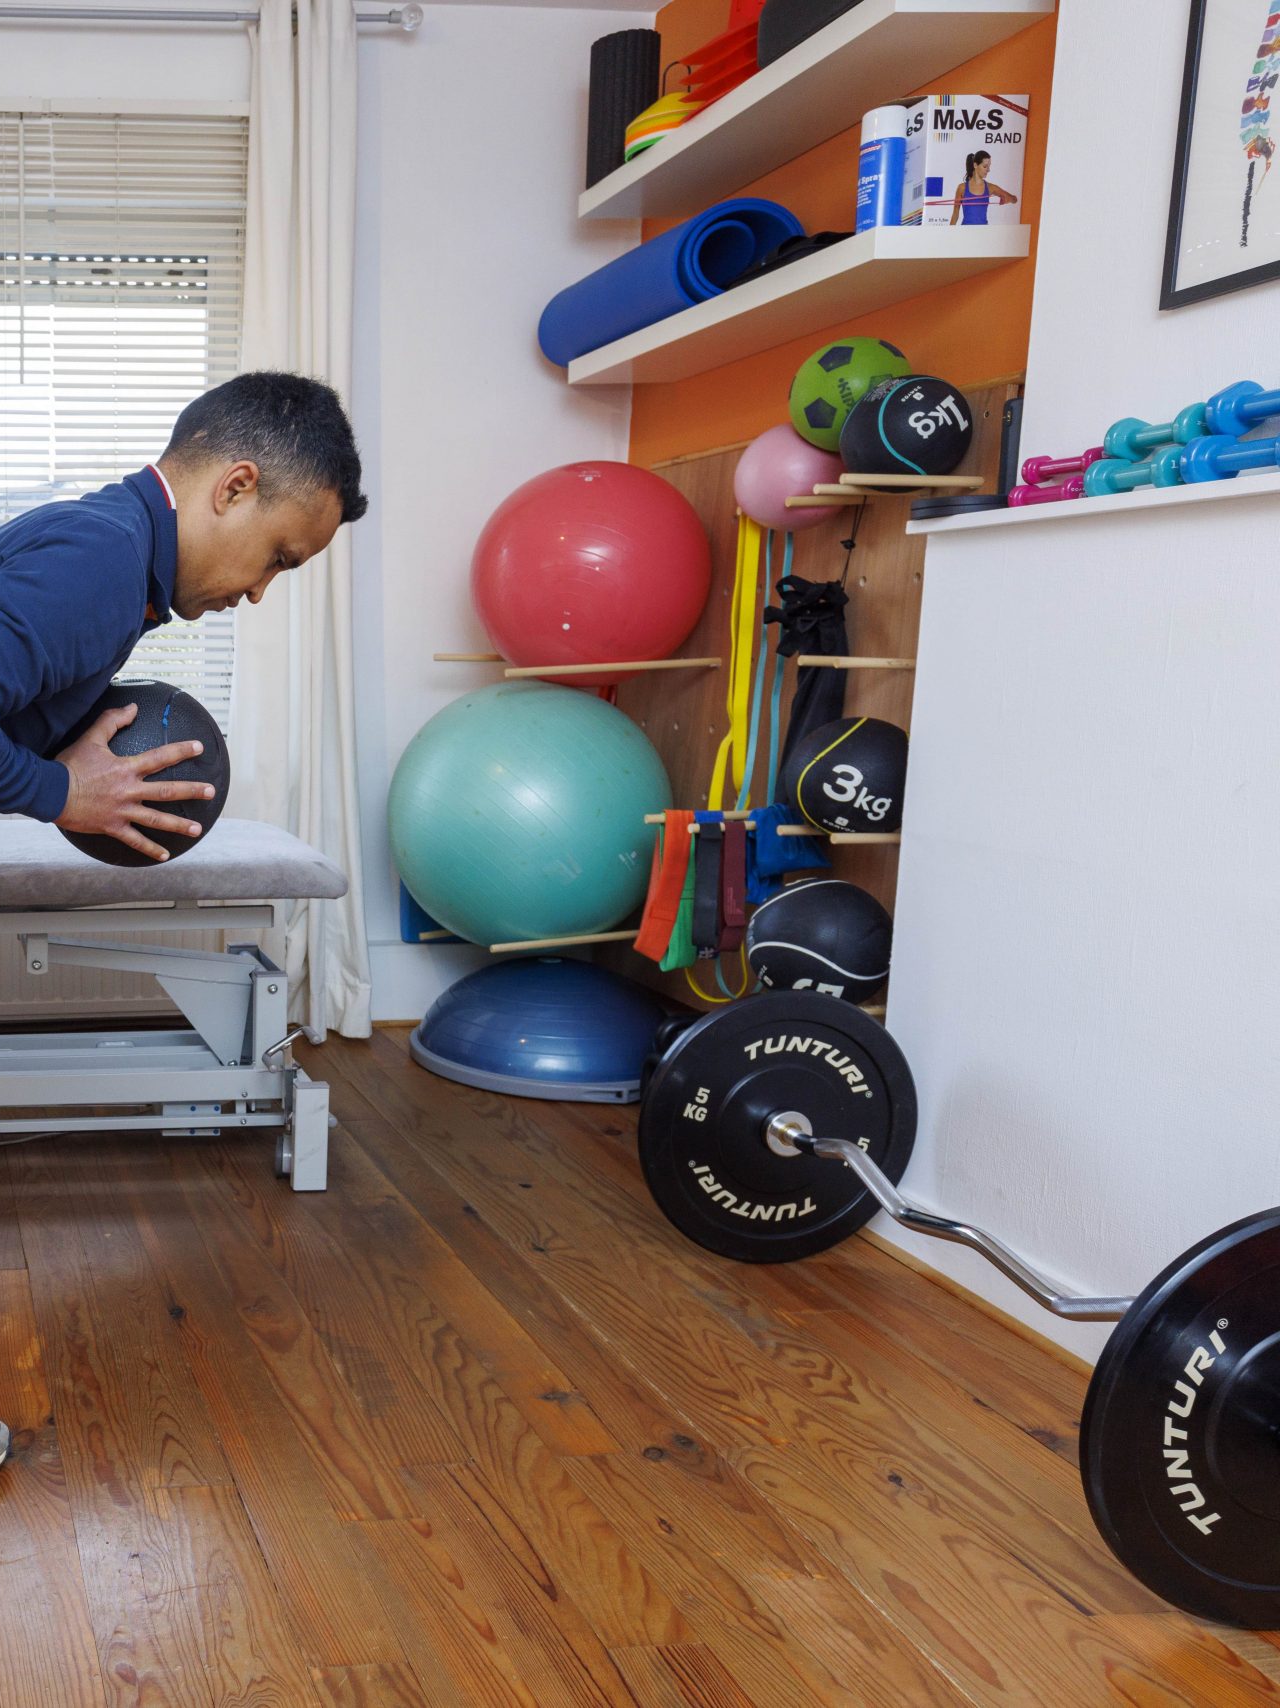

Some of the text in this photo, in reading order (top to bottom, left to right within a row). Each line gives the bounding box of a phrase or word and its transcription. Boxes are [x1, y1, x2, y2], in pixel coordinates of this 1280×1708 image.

[933, 108, 1004, 130] MoVeS
[984, 133, 1022, 144] BAND
[908, 395, 969, 440] 1kg
[822, 763, 893, 822] 3kg
[695, 1087, 710, 1104] 5
[683, 1103, 708, 1122] KG
